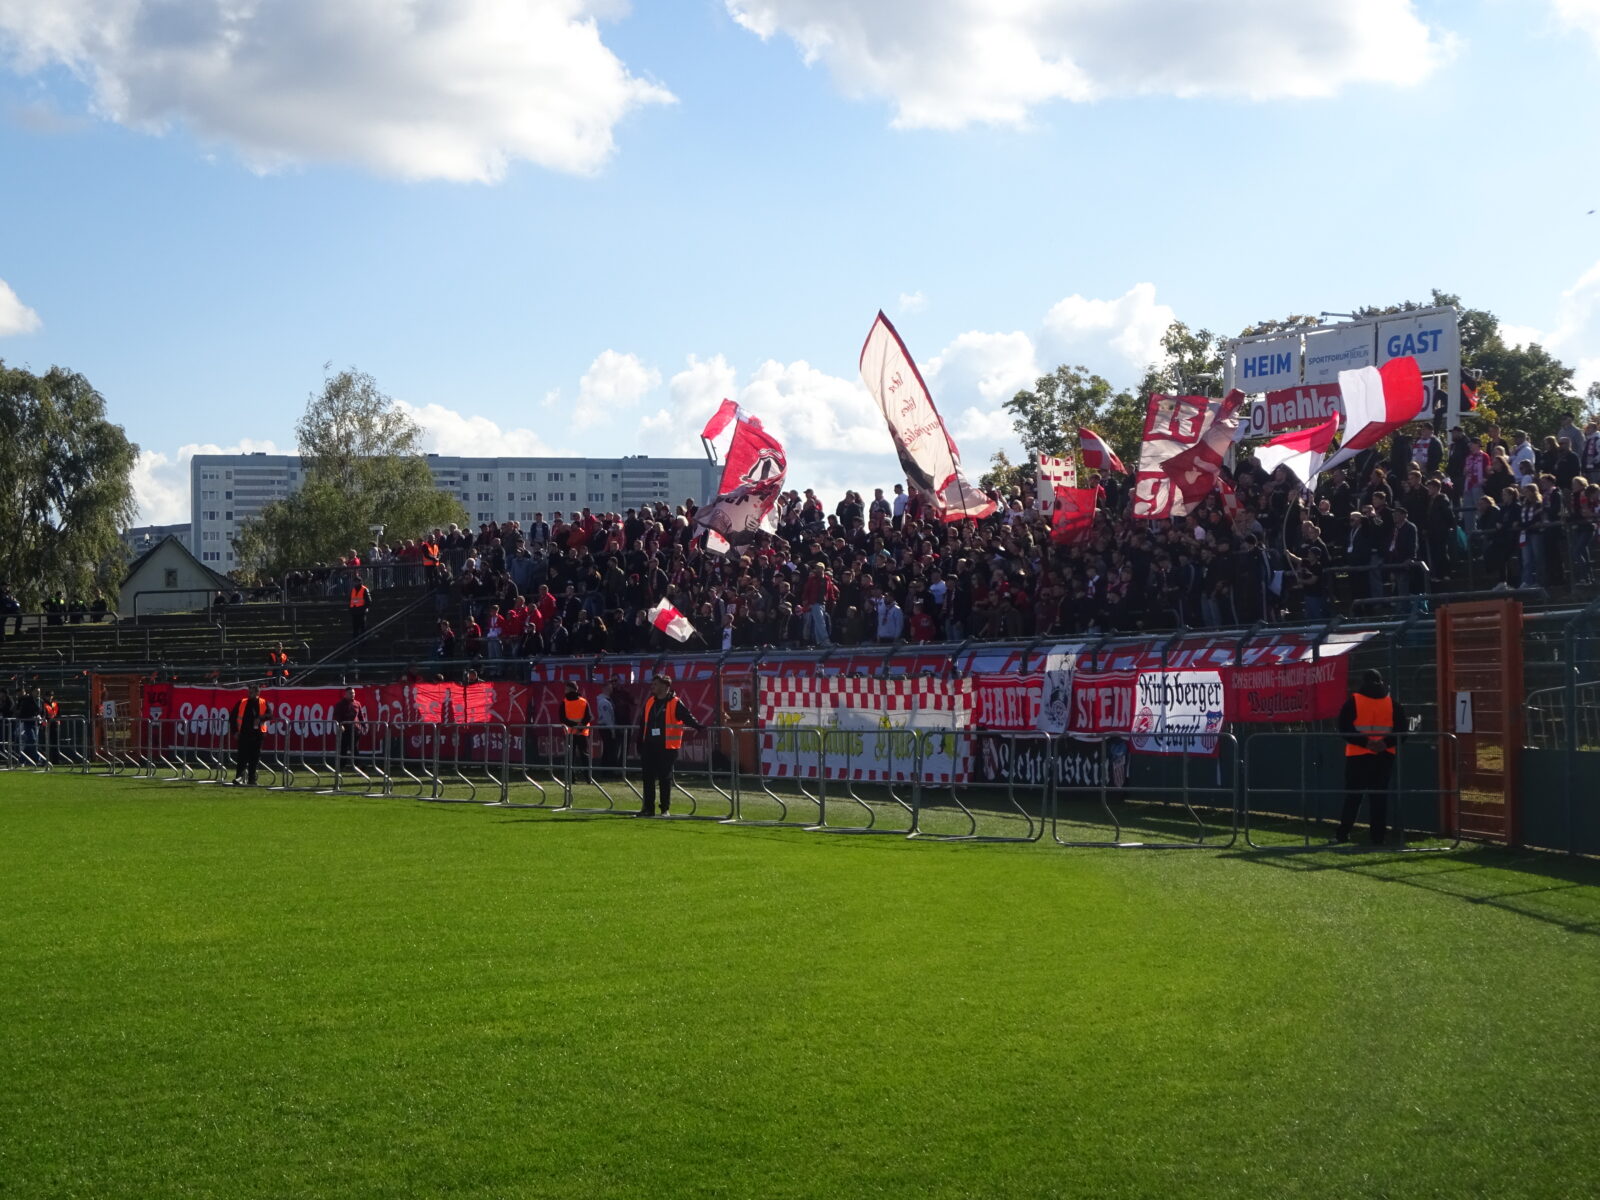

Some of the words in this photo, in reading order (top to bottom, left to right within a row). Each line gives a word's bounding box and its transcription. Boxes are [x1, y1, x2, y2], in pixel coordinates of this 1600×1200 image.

[1388, 329, 1442, 357] GAST
[1244, 352, 1291, 378] HEIM
[1308, 352, 1349, 365] SPORTFORUM
[1270, 388, 1344, 425] nahka
[105, 704, 112, 716] 5
[730, 691, 738, 708] 6
[1460, 700, 1467, 725] 7
